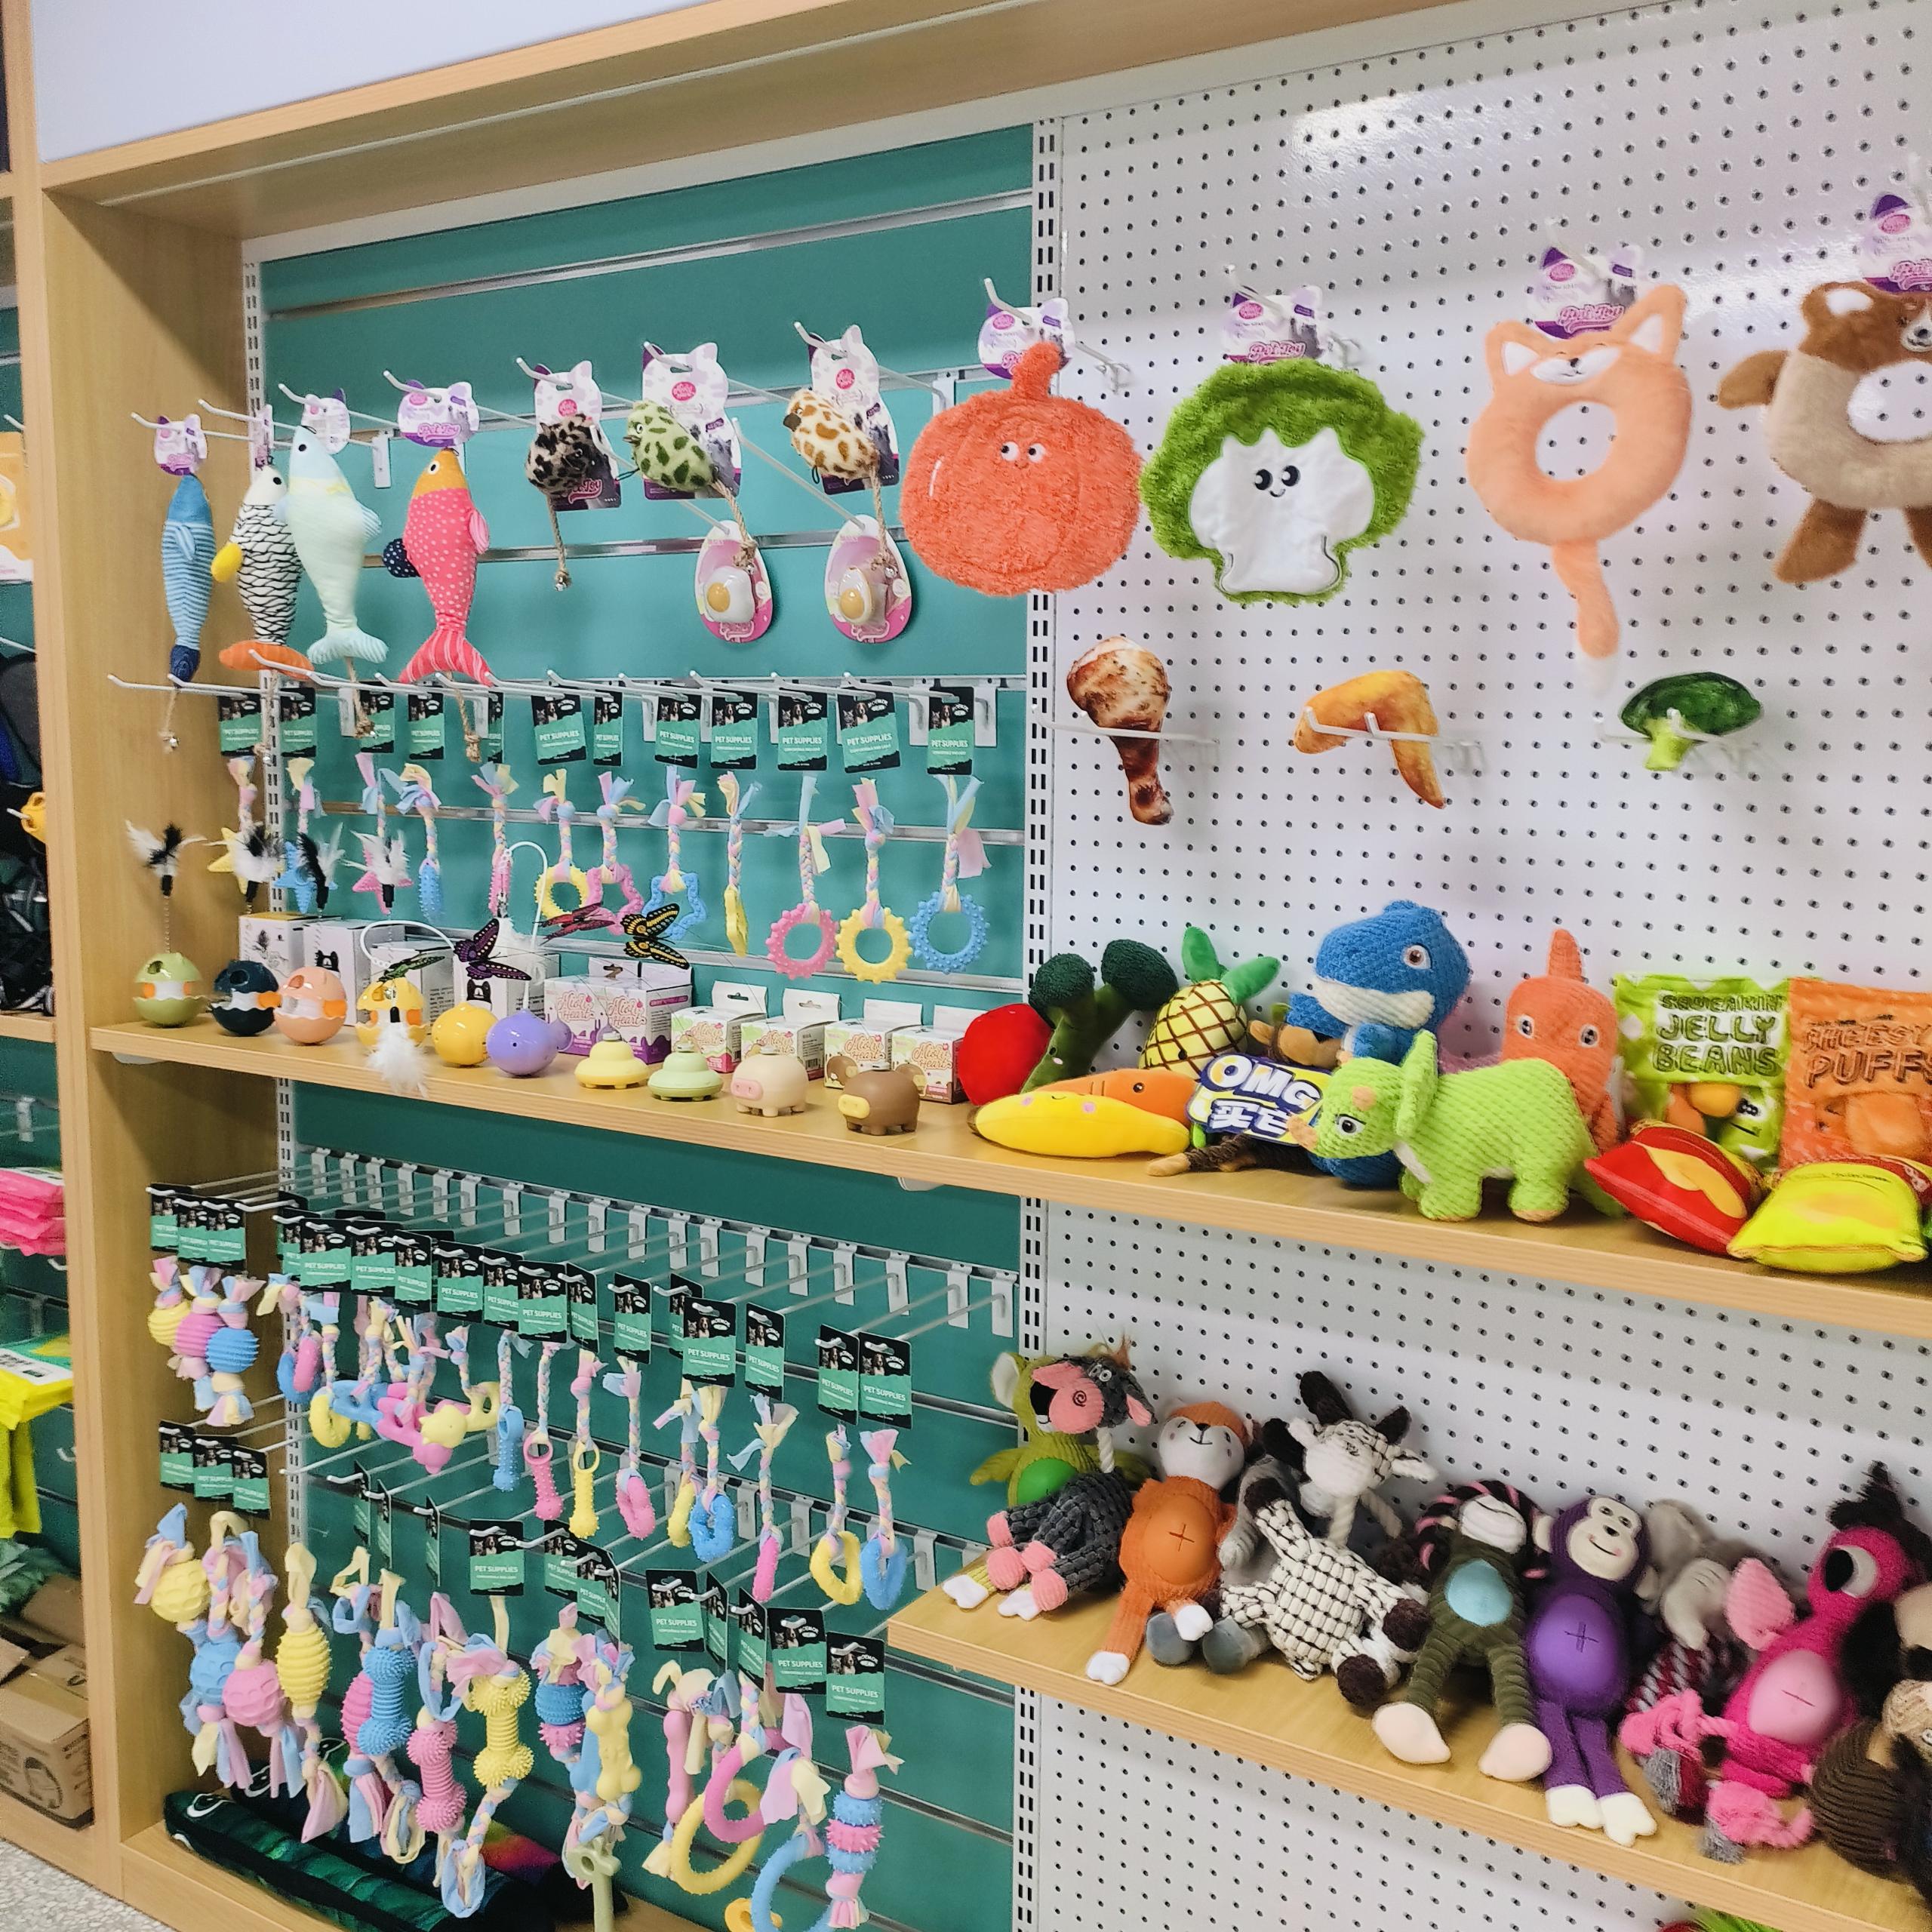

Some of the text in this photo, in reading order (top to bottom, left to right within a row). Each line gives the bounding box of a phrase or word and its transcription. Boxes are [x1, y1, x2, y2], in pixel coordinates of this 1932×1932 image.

[660, 731, 695, 743] PET SUPPLIES
[725, 736, 752, 744] SUPPLIES
[847, 733, 892, 746] PET SUPPLIES
[942, 740, 968, 748] SUPPLIES
[1657, 1014, 1776, 1044] JELLY
[1654, 1043, 1782, 1077] BEANS
[1209, 1054, 1321, 1110] OMG
[534, 1309, 562, 1318] SUPPLIES
[626, 1324, 648, 1338] SUPPLIES
[700, 1350, 731, 1361] SUPPLIES
[822, 1378, 854, 1396] PET SUPPLIES
[864, 1385, 906, 1401] PET SUPPLIES
[845, 1687, 878, 1698] SUPPLIES
